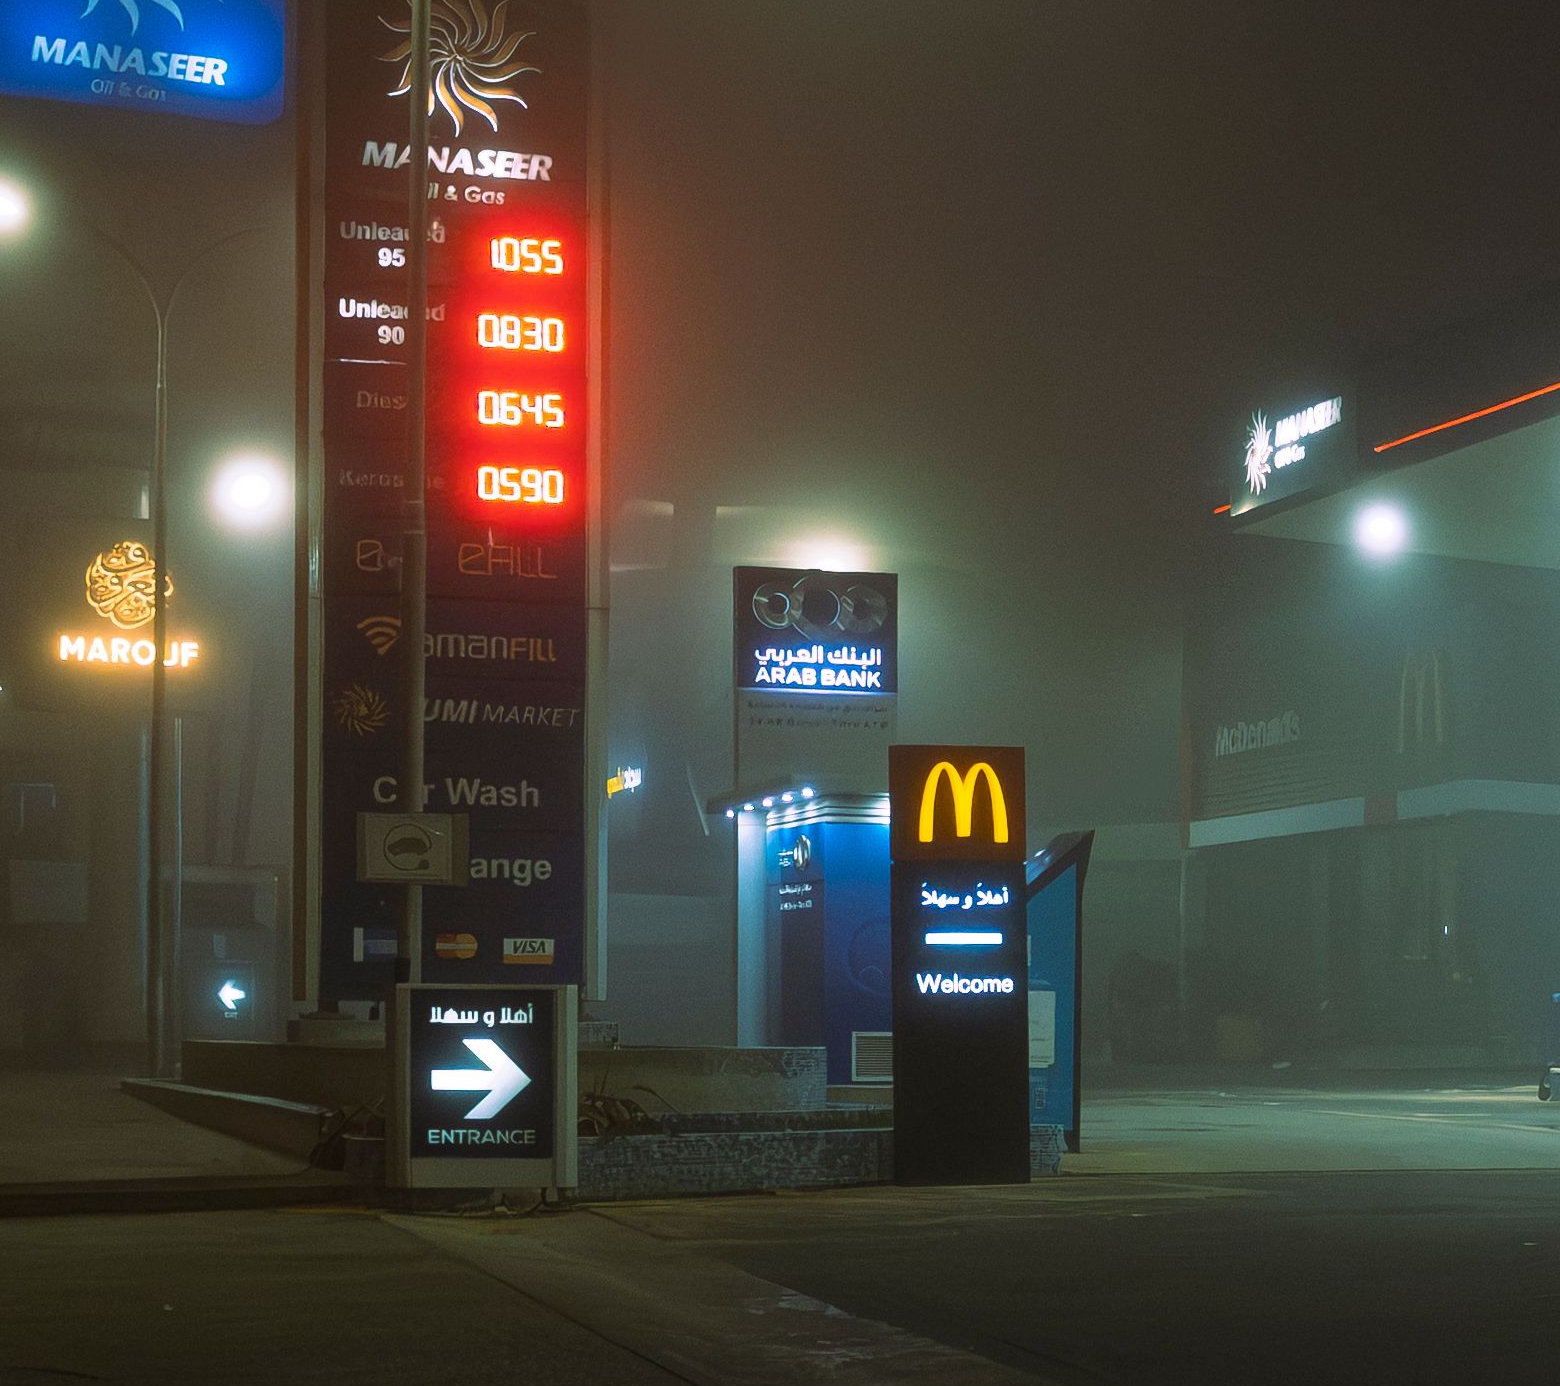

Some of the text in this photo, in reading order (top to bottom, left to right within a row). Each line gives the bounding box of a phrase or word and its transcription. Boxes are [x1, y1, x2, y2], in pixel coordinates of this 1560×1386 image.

[31, 35, 228, 86] MANASEER
[444, 185, 458, 201] &
[464, 186, 505, 205] Gas
[340, 220, 445, 243] Unlead
[378, 247, 406, 267] 95
[339, 298, 445, 321] Unlead
[378, 324, 405, 345] 90
[754, 644, 882, 670] البنك العربي
[754, 666, 882, 689] ARAB BANK
[424, 698, 581, 727] UMI MARKET
[372, 776, 540, 807] Cr Wash
[469, 857, 553, 886] ange
[961, 895, 973, 910] و
[512, 939, 546, 954] VISA
[916, 972, 1014, 994] Welcome
[429, 1006, 479, 1024] سهلا
[482, 1011, 495, 1028] و
[428, 1129, 536, 1144] ENTRANCE
